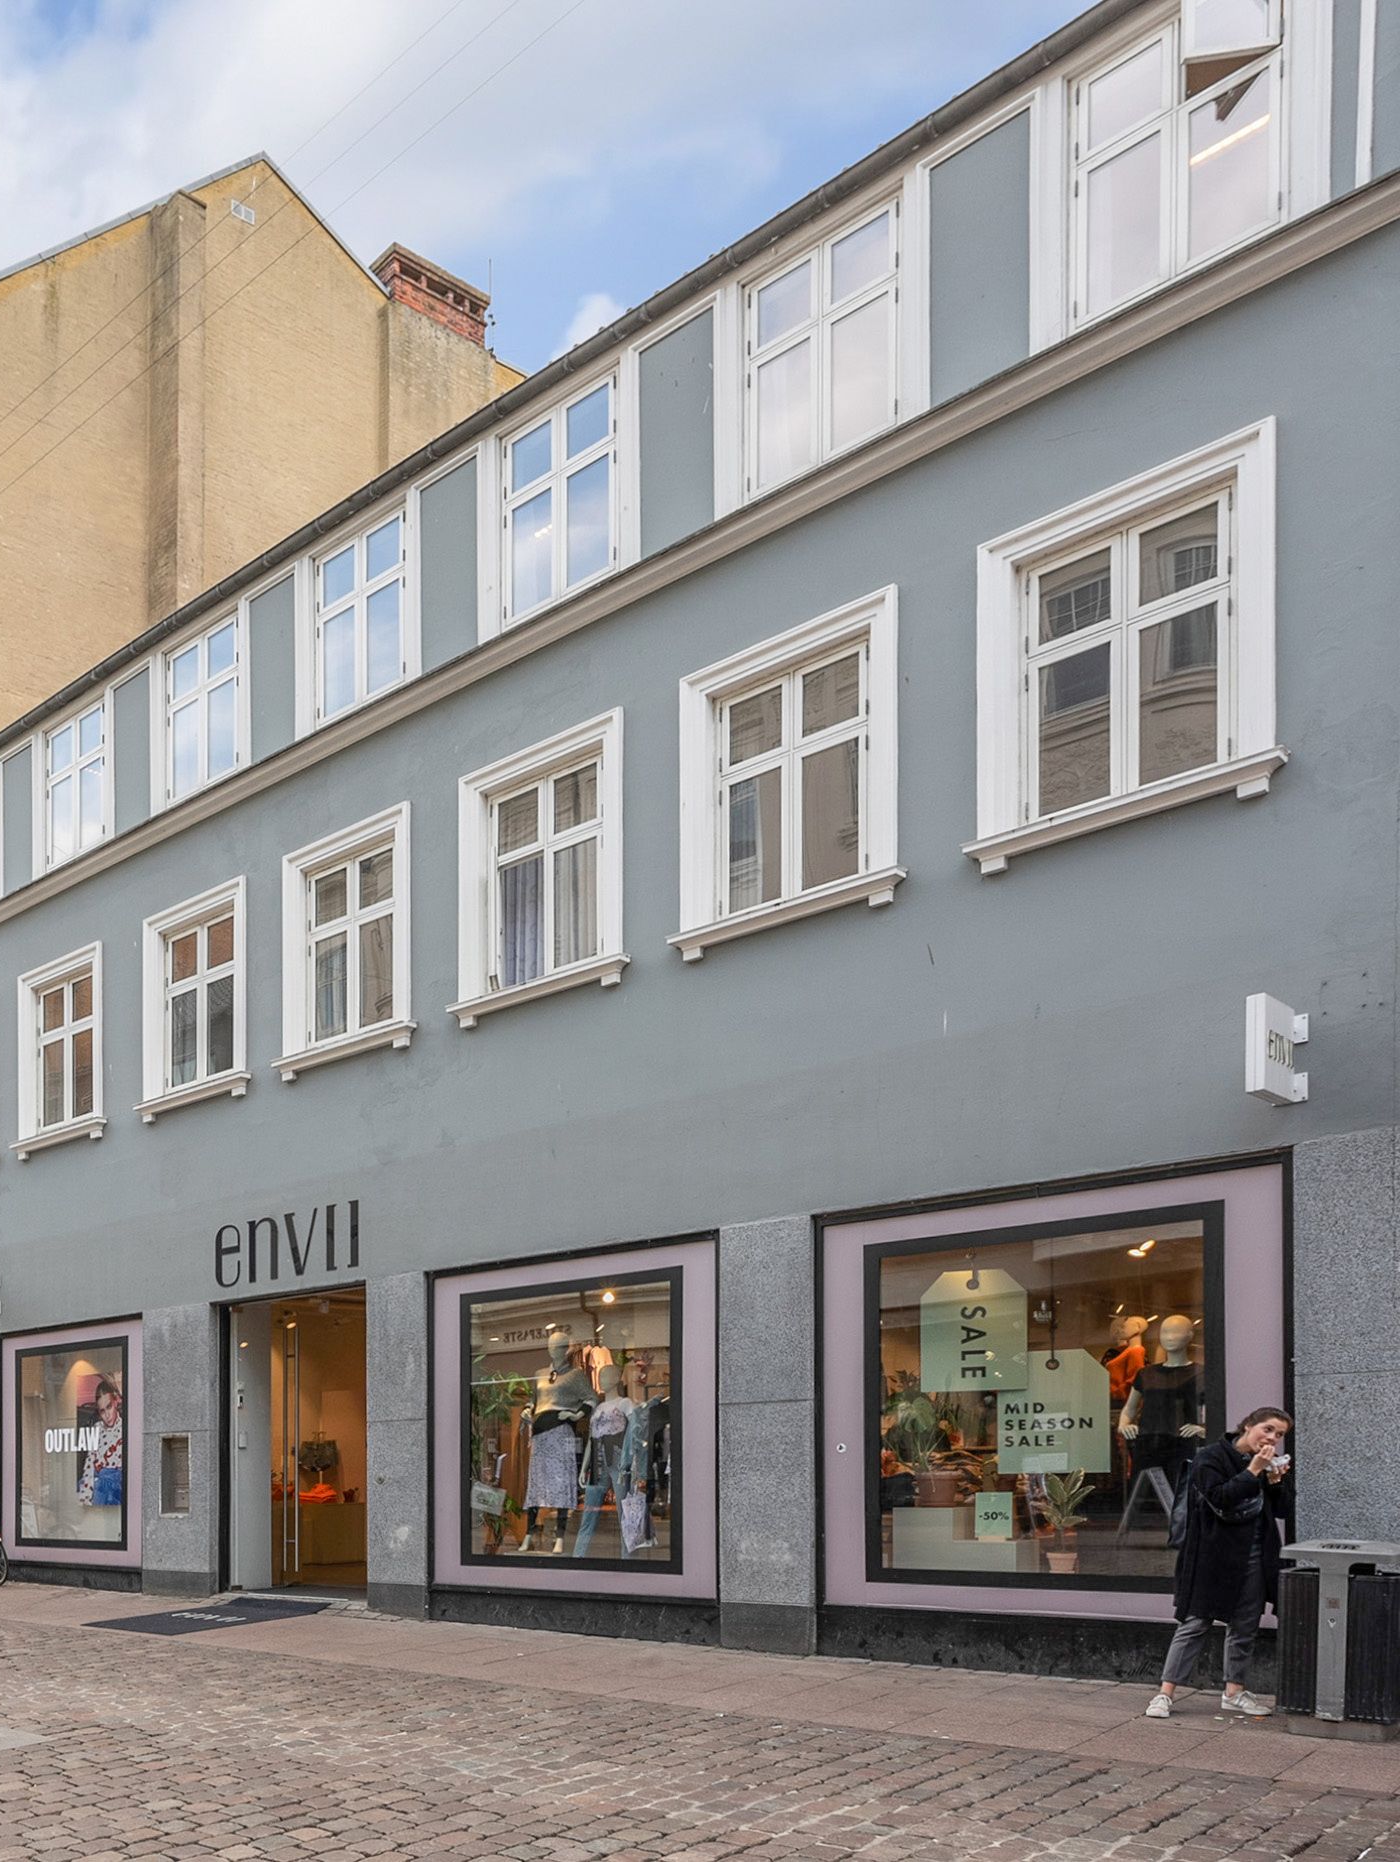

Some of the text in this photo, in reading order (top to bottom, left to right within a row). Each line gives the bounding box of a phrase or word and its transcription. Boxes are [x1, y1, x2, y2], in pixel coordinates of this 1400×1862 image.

[960, 1305, 987, 1378] SALE
[1005, 1402, 1045, 1415] MID
[1005, 1417, 1093, 1431] SEASON
[45, 1427, 100, 1453] OUTLAW
[1005, 1435, 1055, 1448] SALE
[979, 1511, 1010, 1521] -50%
